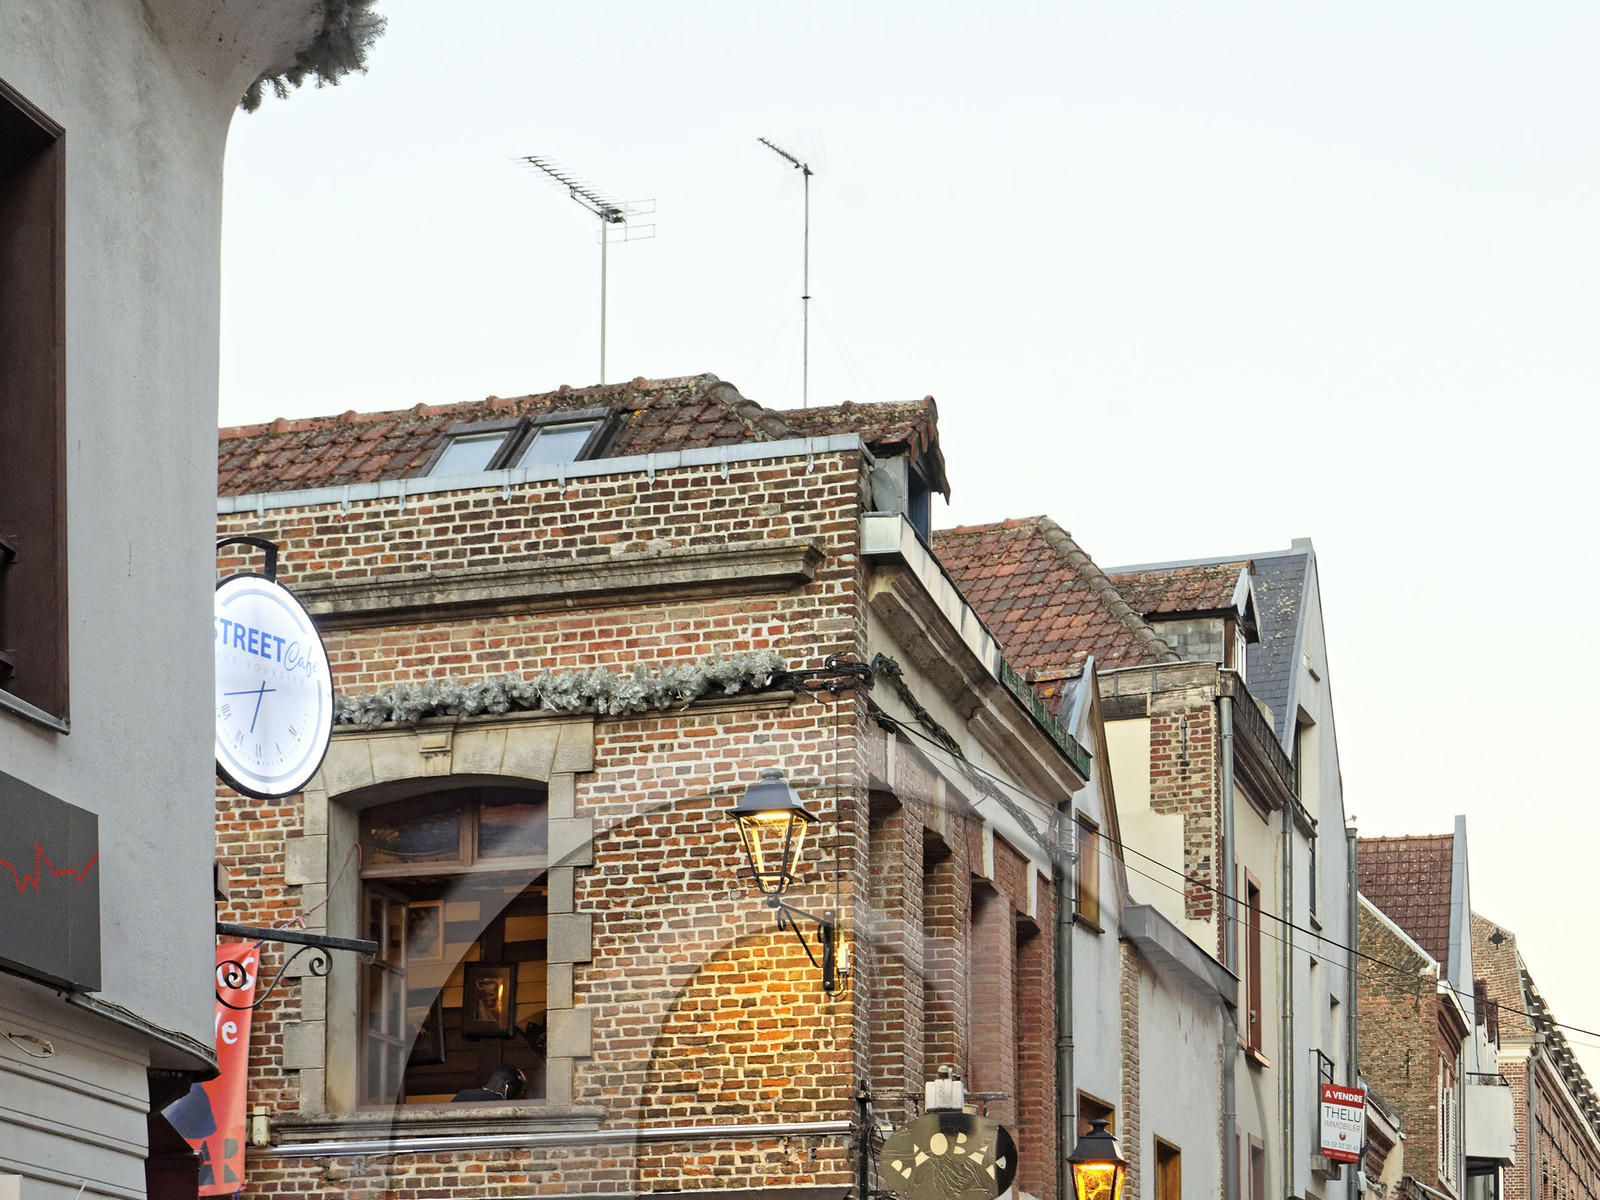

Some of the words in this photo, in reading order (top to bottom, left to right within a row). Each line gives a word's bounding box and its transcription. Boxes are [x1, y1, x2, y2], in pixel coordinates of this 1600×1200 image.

[1325, 1090, 1332, 1099] A
[1333, 1091, 1364, 1104] VENDRE
[1325, 1105, 1362, 1123] THELU
